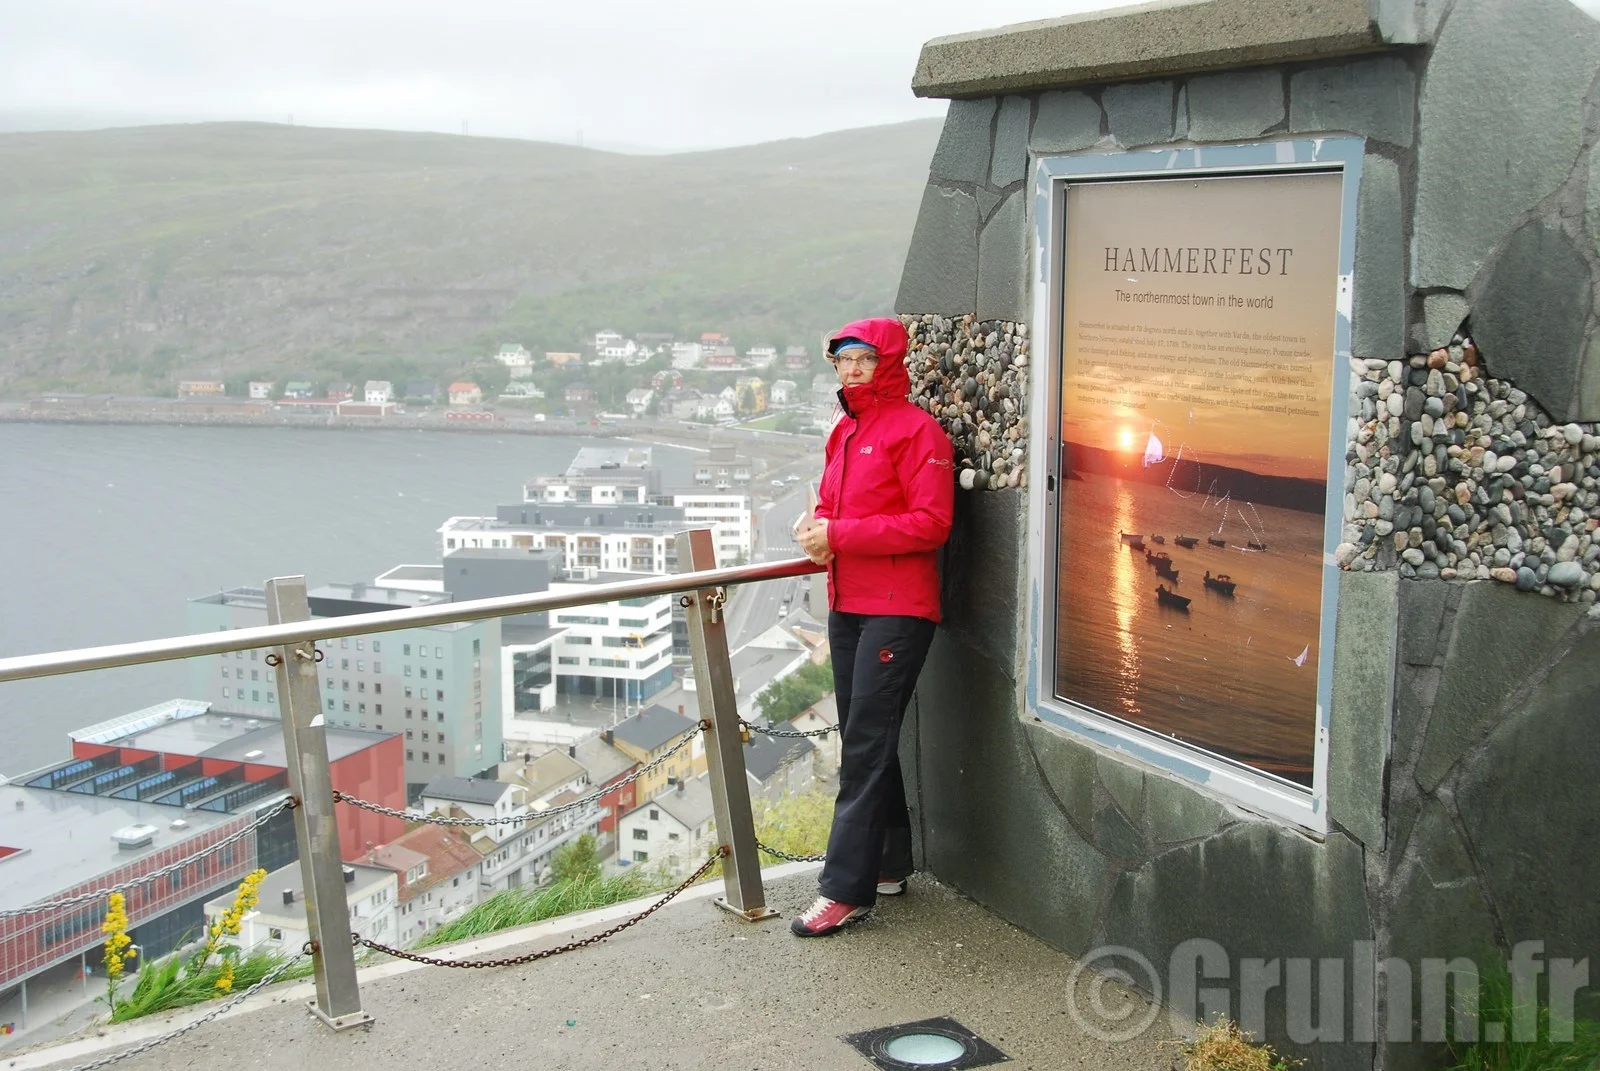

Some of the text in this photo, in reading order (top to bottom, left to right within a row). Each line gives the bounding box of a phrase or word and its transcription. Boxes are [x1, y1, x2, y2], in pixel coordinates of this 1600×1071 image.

[1104, 247, 1293, 275] HAMMERFEST
[1115, 289, 1273, 309] The northernmost town in the world
[1263, 333, 1281, 342] oldest
